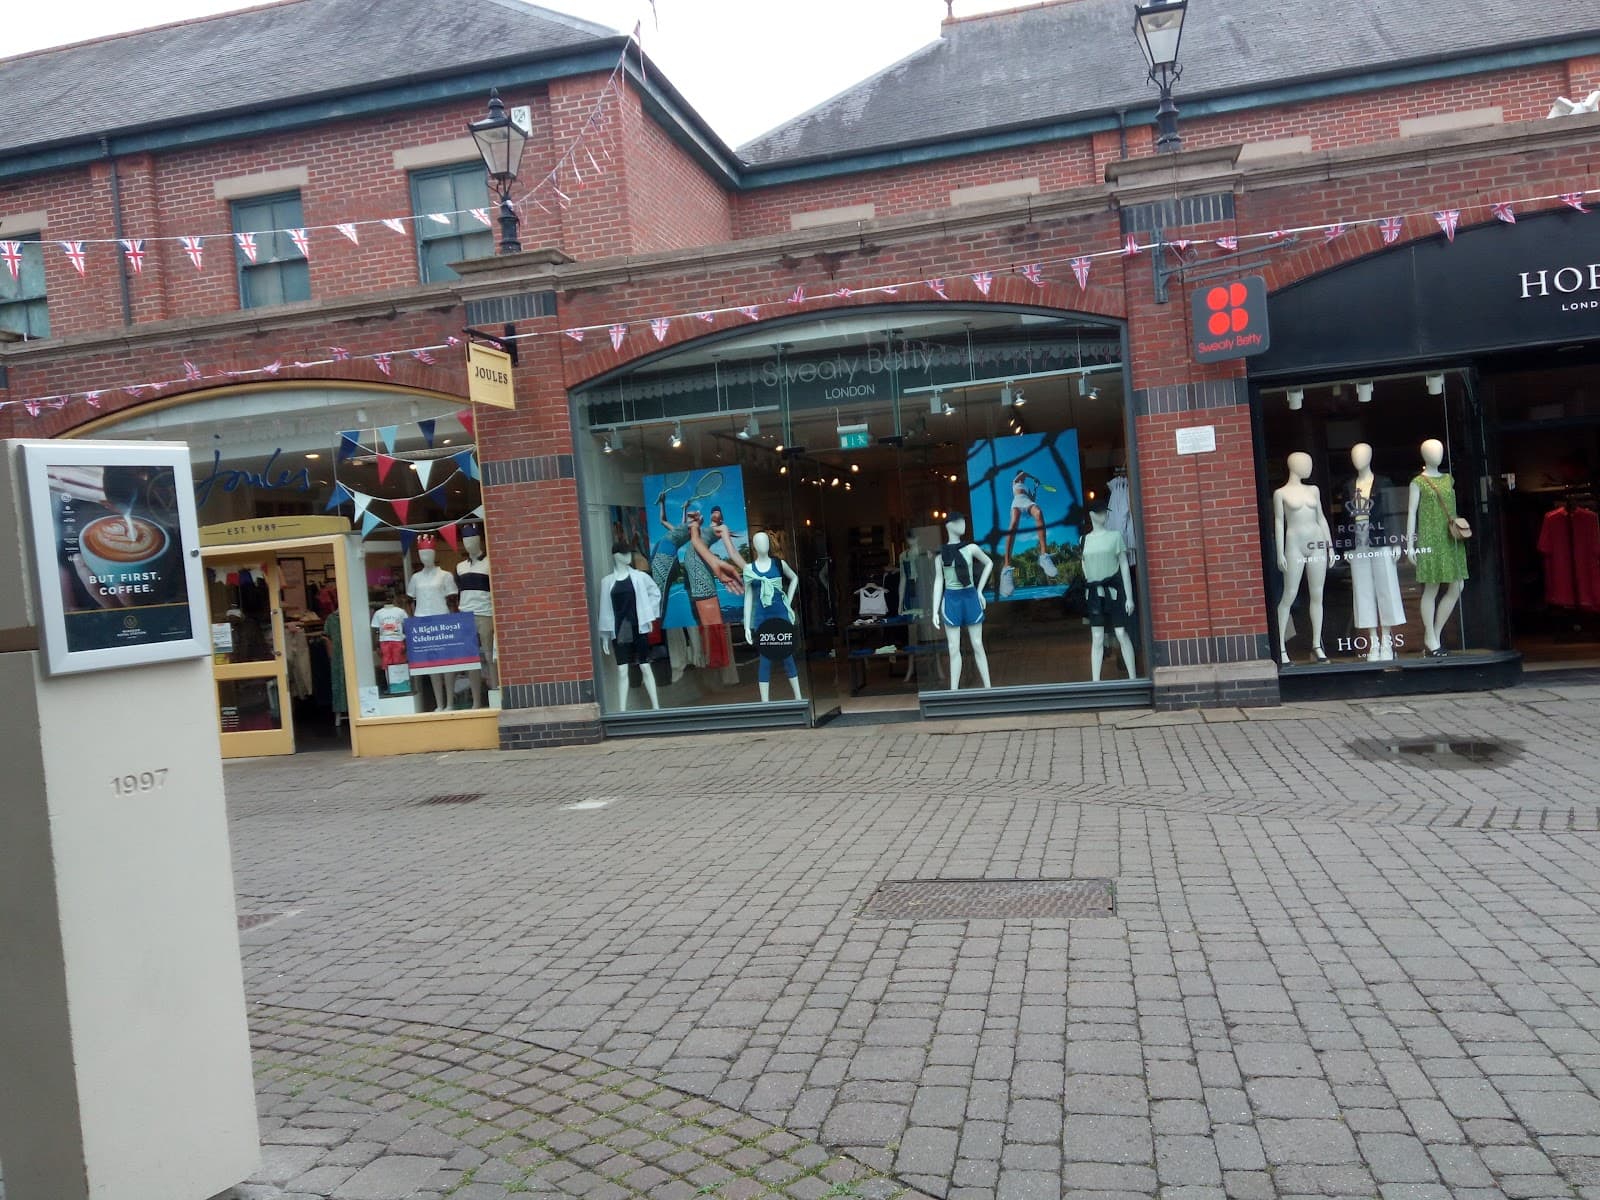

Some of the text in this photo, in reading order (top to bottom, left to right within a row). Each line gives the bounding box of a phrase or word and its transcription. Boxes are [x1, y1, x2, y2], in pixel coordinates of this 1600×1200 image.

[1198, 333, 1262, 353] Sweaty Betty
[762, 344, 933, 387] Sweaty Betty
[475, 366, 508, 384] JOULES
[825, 384, 875, 400] LONDON
[252, 523, 276, 533] 1989
[1338, 521, 1385, 533] ROYAL
[1306, 533, 1418, 549] CELEBRATIONS
[89, 571, 161, 584] BUT FIRST,
[99, 584, 155, 596] COFFEE.
[418, 625, 439, 633] Right
[440, 622, 460, 631] Royal
[412, 633, 454, 643] Celebration
[759, 632, 793, 641] 20% OFF
[1337, 633, 1405, 651] HOBBS
[110, 768, 169, 797] 1997
